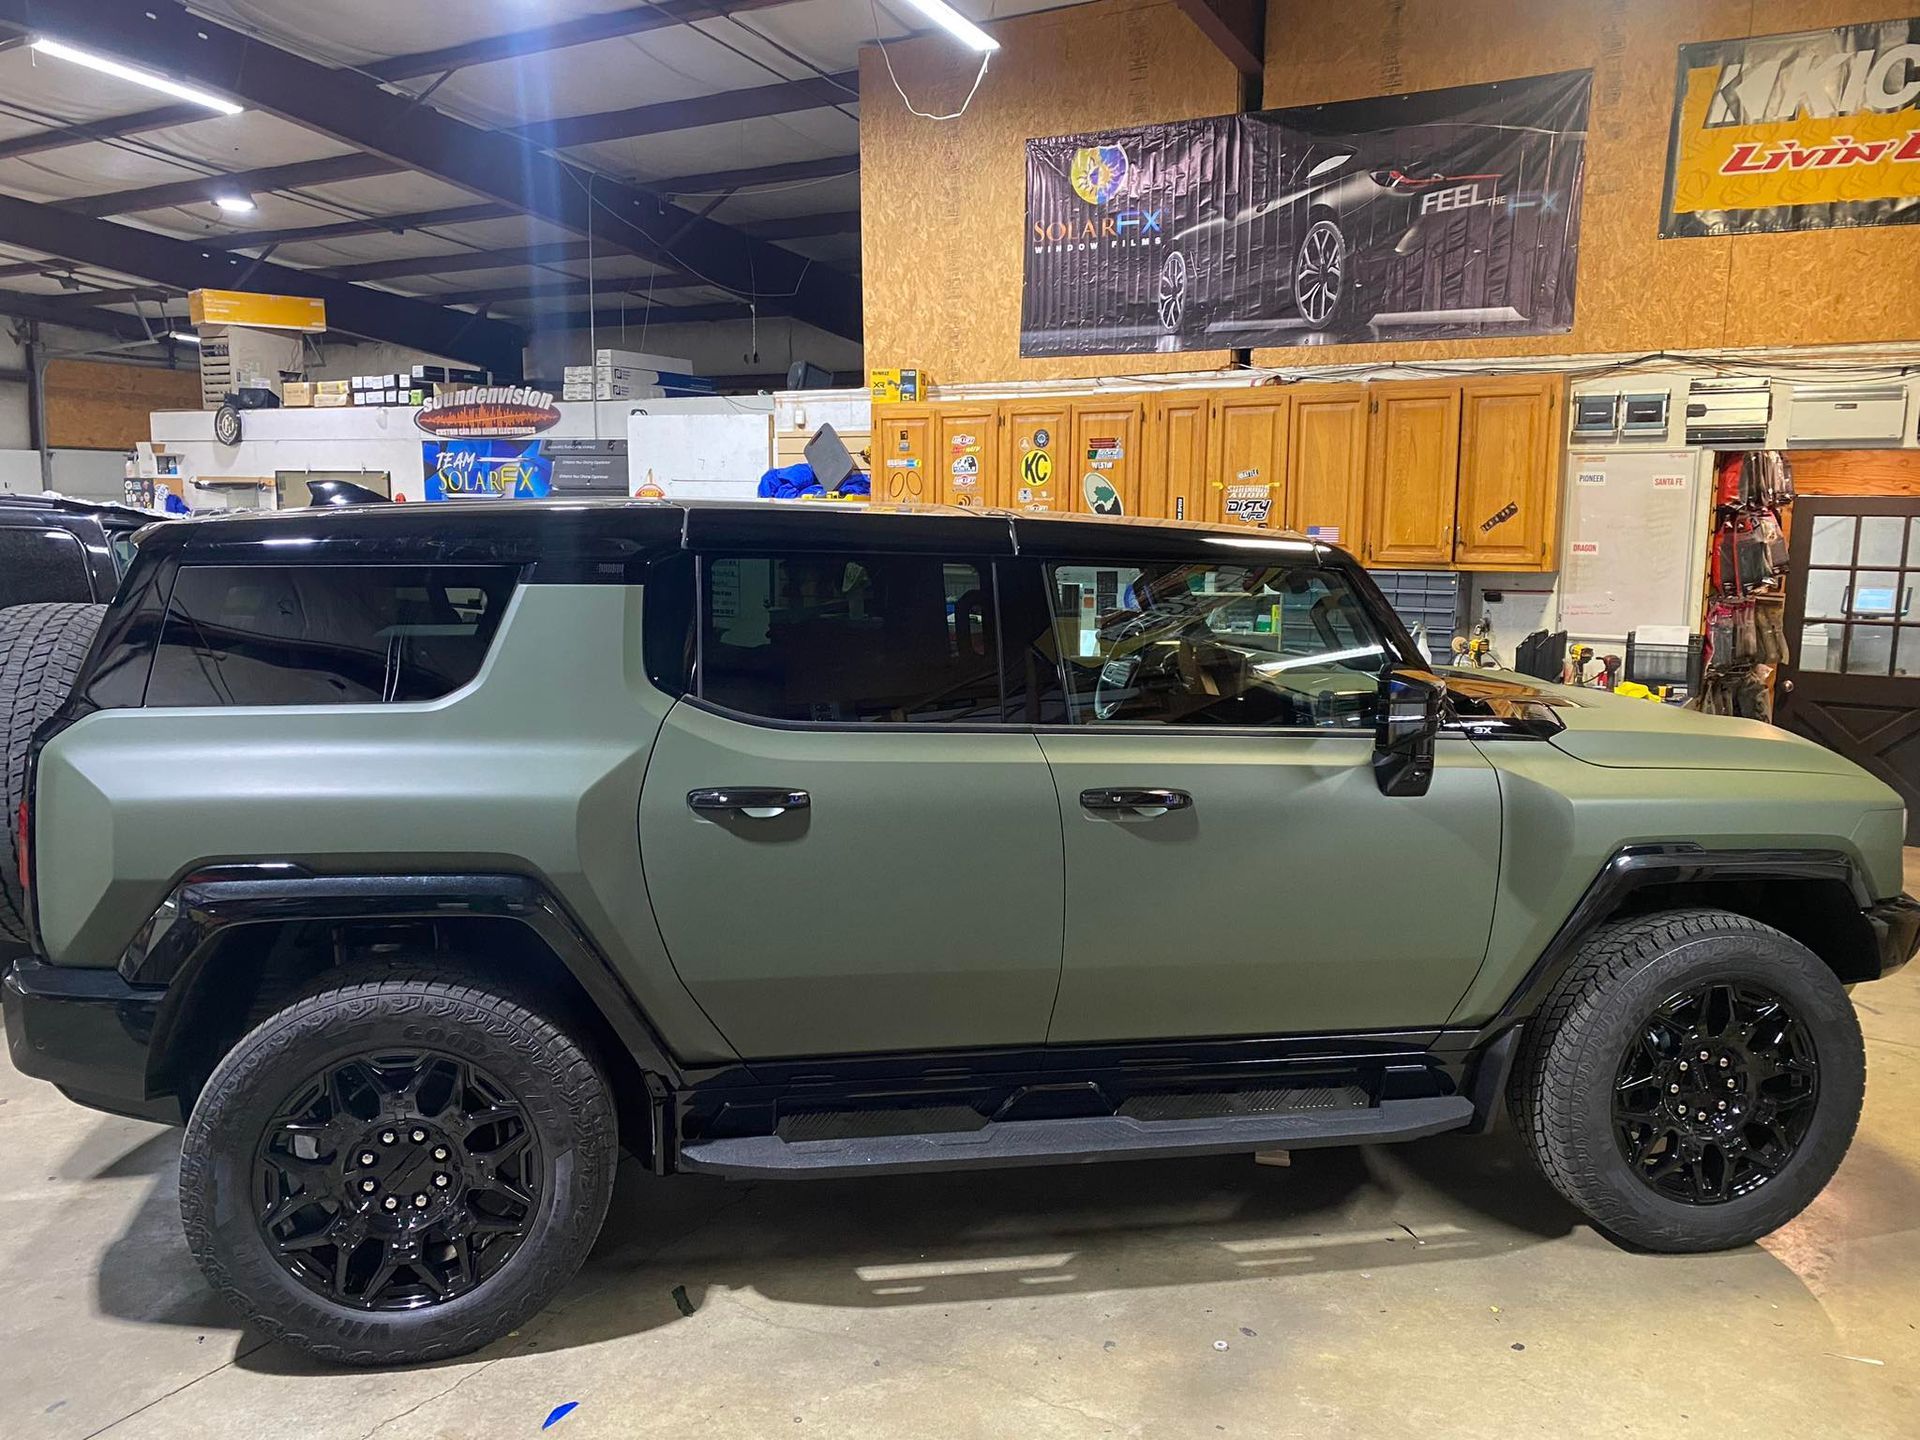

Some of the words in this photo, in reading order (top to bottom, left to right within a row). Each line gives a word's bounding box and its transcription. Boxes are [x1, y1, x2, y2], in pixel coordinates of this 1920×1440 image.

[1420, 183, 1487, 215] FEEL
[1487, 195, 1507, 207] THE
[1034, 242, 1098, 254] WINDOW
[1111, 236, 1162, 248] FILMS
[423, 385, 554, 412] soundenvision
[436, 451, 477, 470] TEAM
[1025, 452, 1049, 484] KC
[438, 465, 535, 492] SOLARFX
[1578, 474, 1604, 483] PIONEER
[1654, 478, 1675, 486] SANTA
[1675, 478, 1684, 486] FE
[1573, 543, 1597, 552] DRAGON
